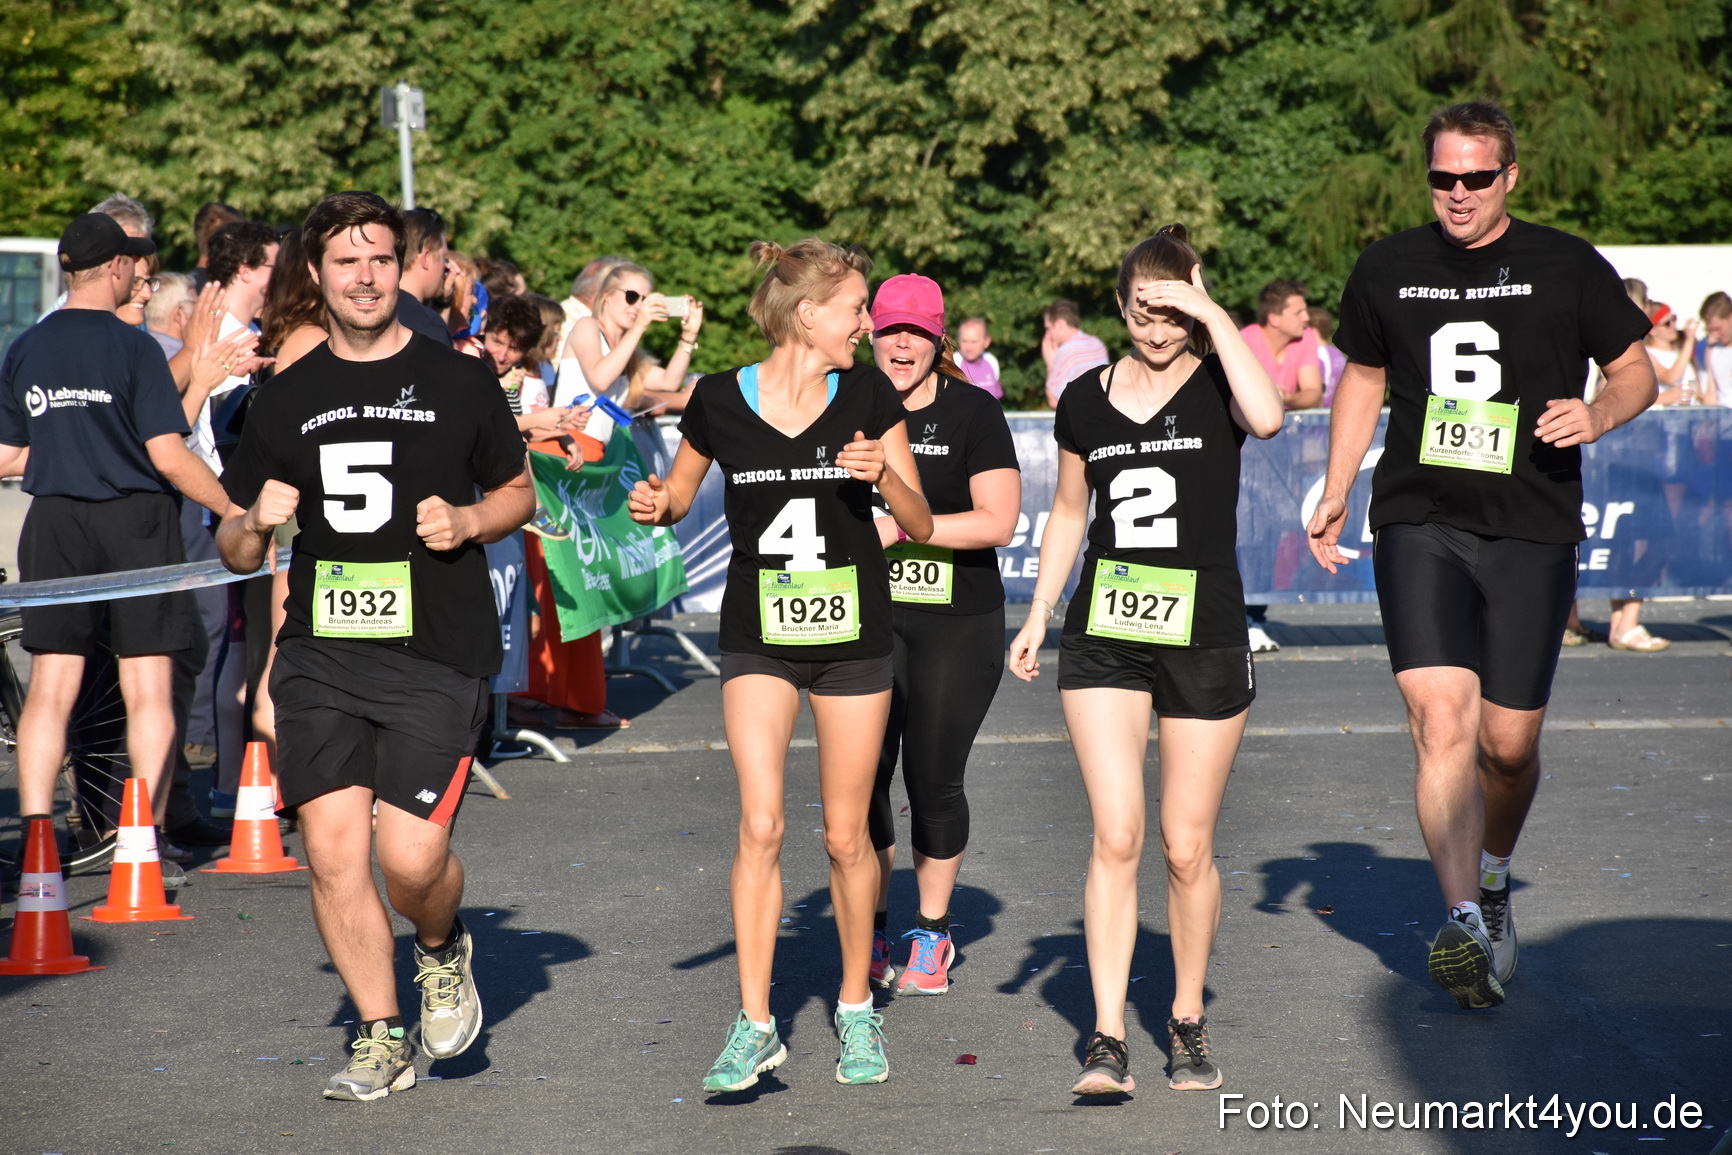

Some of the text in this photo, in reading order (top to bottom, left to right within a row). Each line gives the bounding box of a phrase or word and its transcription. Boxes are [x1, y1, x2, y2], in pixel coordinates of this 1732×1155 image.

[1399, 284, 1532, 299] SCHOOL RUNERS
[1430, 321, 1501, 401] 6
[47, 387, 112, 403] Lebnshilfe
[301, 406, 436, 434] SCHOOL RUNERS
[1088, 437, 1202, 462] SCHOOL RUNERS
[1435, 422, 1500, 452] 1931
[319, 441, 393, 533] 5
[733, 467, 851, 484] SCHOOL RUNERS
[1109, 466, 1177, 548] 2
[758, 498, 826, 571] 4
[889, 559, 940, 585] 930
[900, 584, 916, 592] Leon
[918, 585, 944, 593] Melissa
[325, 589, 397, 616] 1932
[772, 595, 846, 624] 1928
[1105, 589, 1180, 622] 1927
[328, 617, 358, 625] Brunner
[1115, 618, 1163, 630] Ludwig Lena
